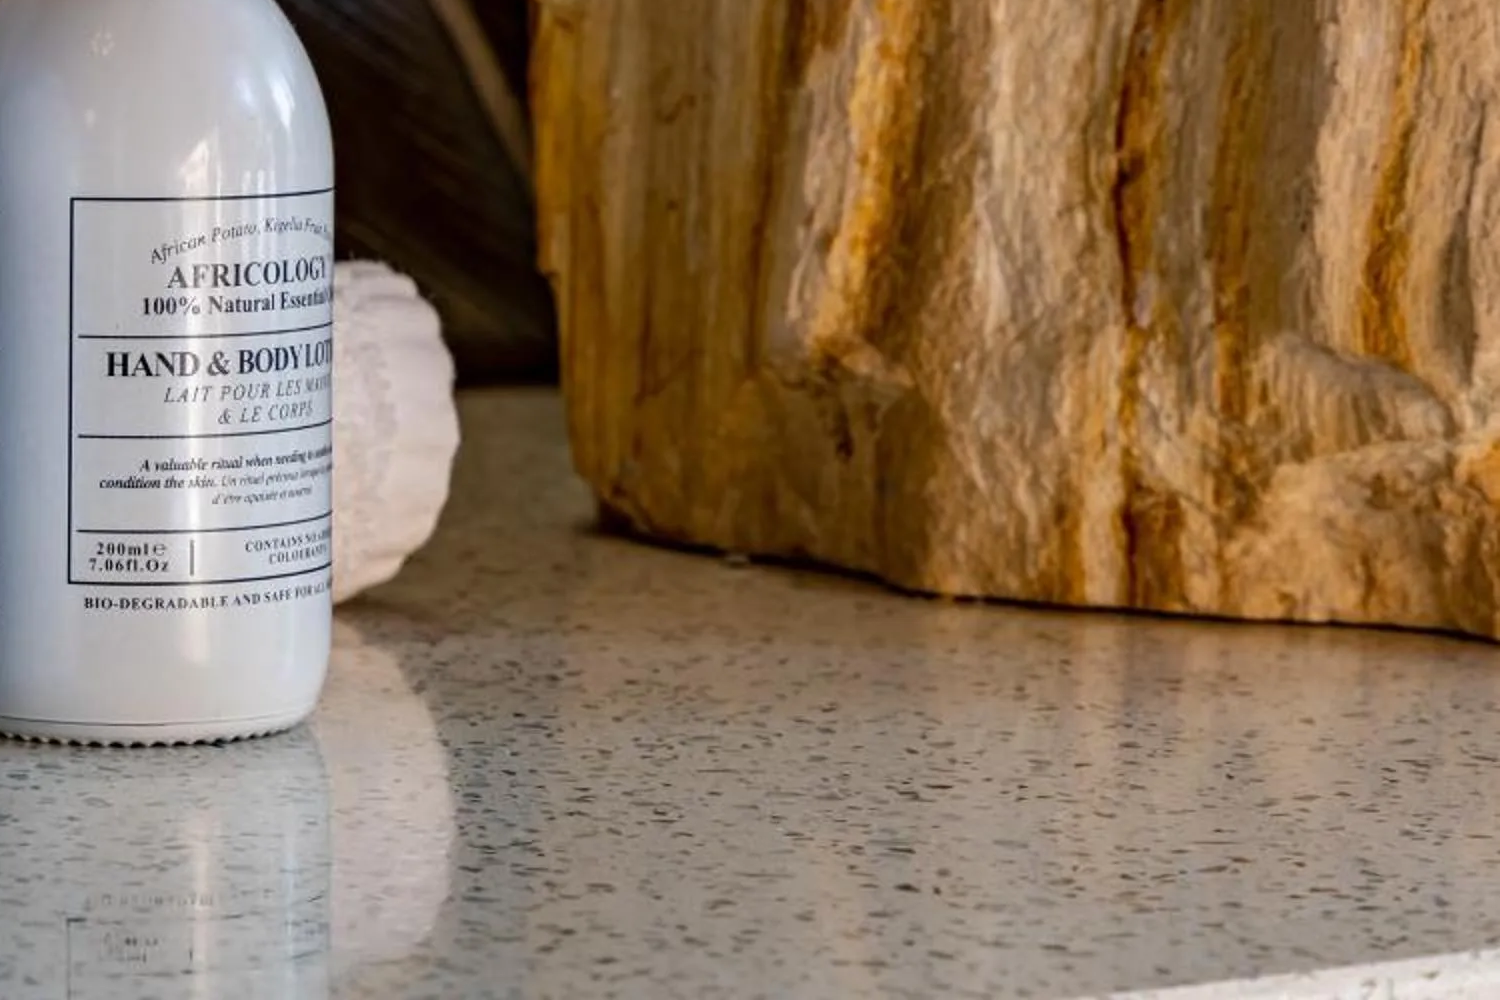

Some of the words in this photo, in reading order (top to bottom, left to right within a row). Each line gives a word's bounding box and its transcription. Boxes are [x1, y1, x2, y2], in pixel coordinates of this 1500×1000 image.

[150, 234, 206, 265] African
[142, 296, 200, 316] 100%
[208, 292, 275, 315] Natural
[106, 351, 199, 377] HAND
[206, 351, 230, 376] &
[238, 343, 303, 374] BODY
[305, 340, 332, 368] LOT
[163, 384, 213, 403] LAIT
[219, 381, 270, 402] POUR
[276, 378, 301, 397] LES
[218, 408, 231, 424] &
[239, 405, 261, 423] LE
[268, 400, 313, 421] CORPS
[139, 459, 150, 472] A
[245, 453, 273, 467] when
[99, 473, 161, 489] condition
[163, 474, 185, 489] the
[244, 535, 303, 553] CONTAINS
[83, 595, 229, 610] BIO-DEGRADABLE
[233, 592, 261, 607] AND
[263, 587, 291, 603] SAFE
